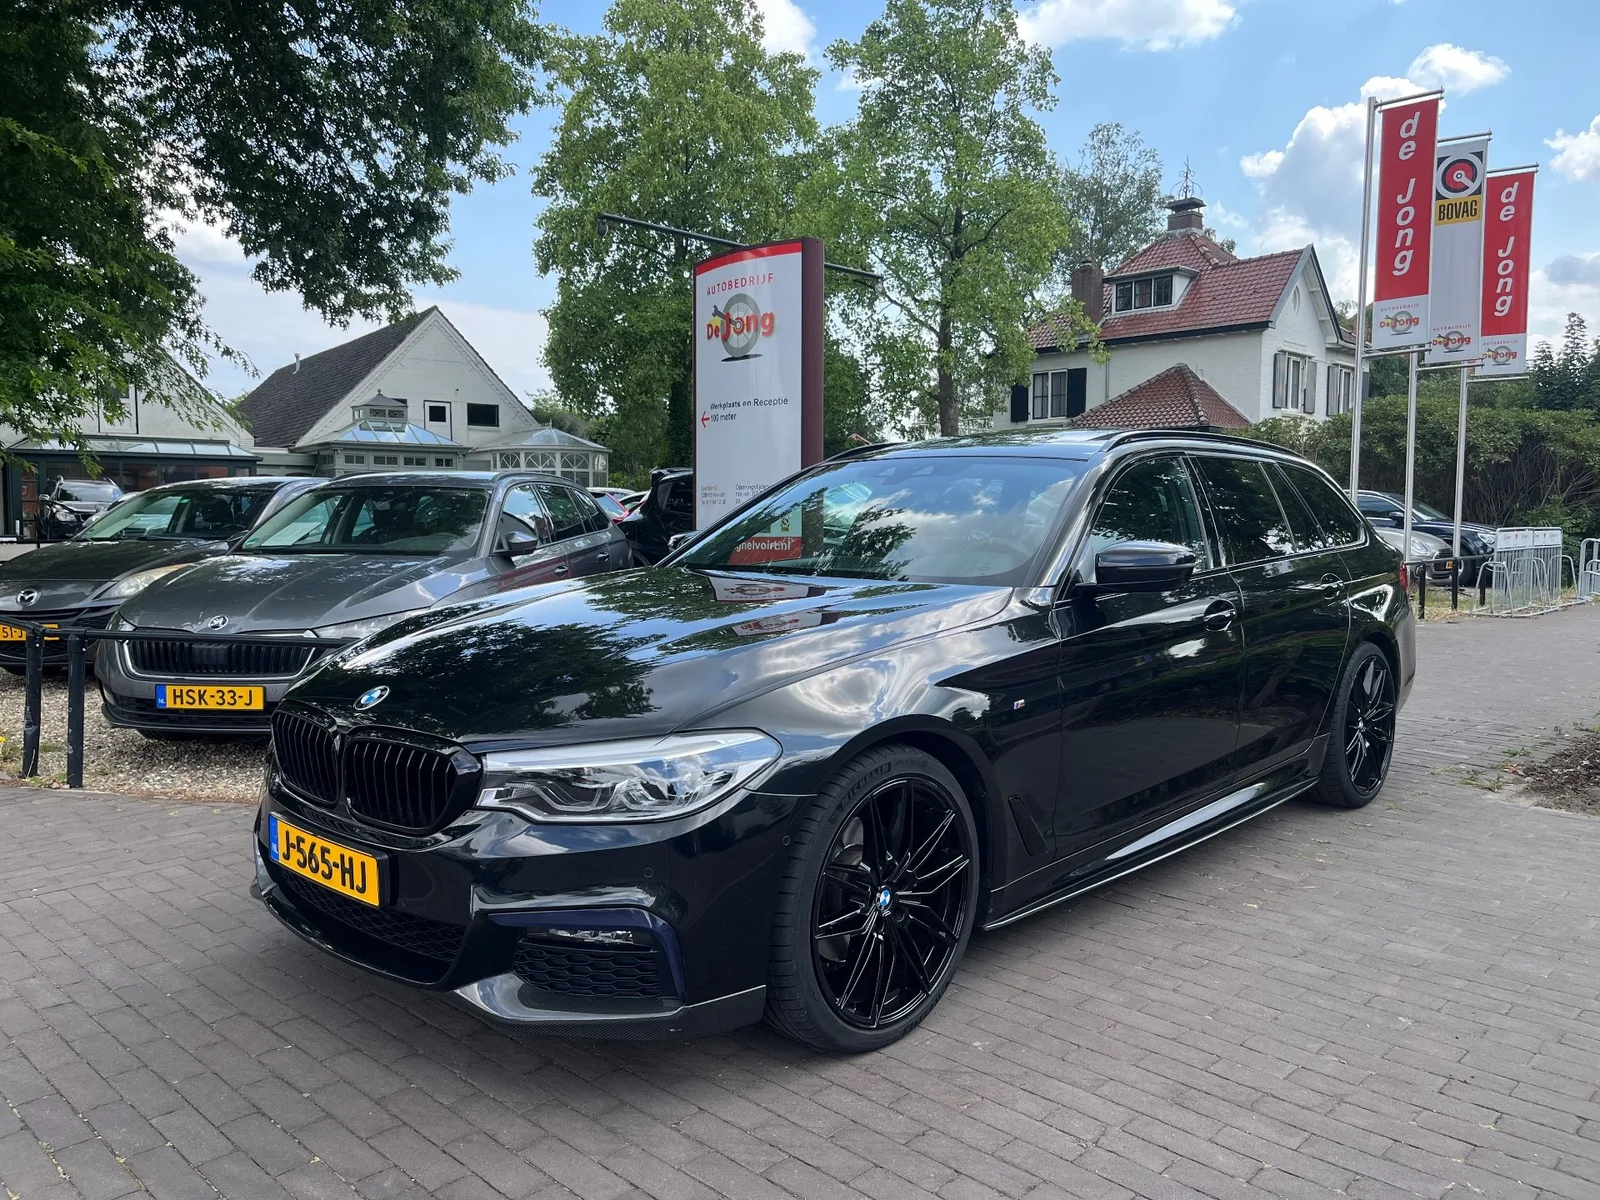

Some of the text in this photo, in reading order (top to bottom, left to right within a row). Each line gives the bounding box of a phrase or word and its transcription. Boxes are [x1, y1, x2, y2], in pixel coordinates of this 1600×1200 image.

[1438, 199, 1478, 221] BOVAG
[706, 272, 774, 297] AUTOBEDRIJF
[710, 399, 741, 411] Werkplaats
[753, 396, 789, 407] Receptie
[720, 412, 737, 421] meter
[172, 688, 253, 707] HSK-33-J
[282, 829, 367, 894] J-565-HJ
